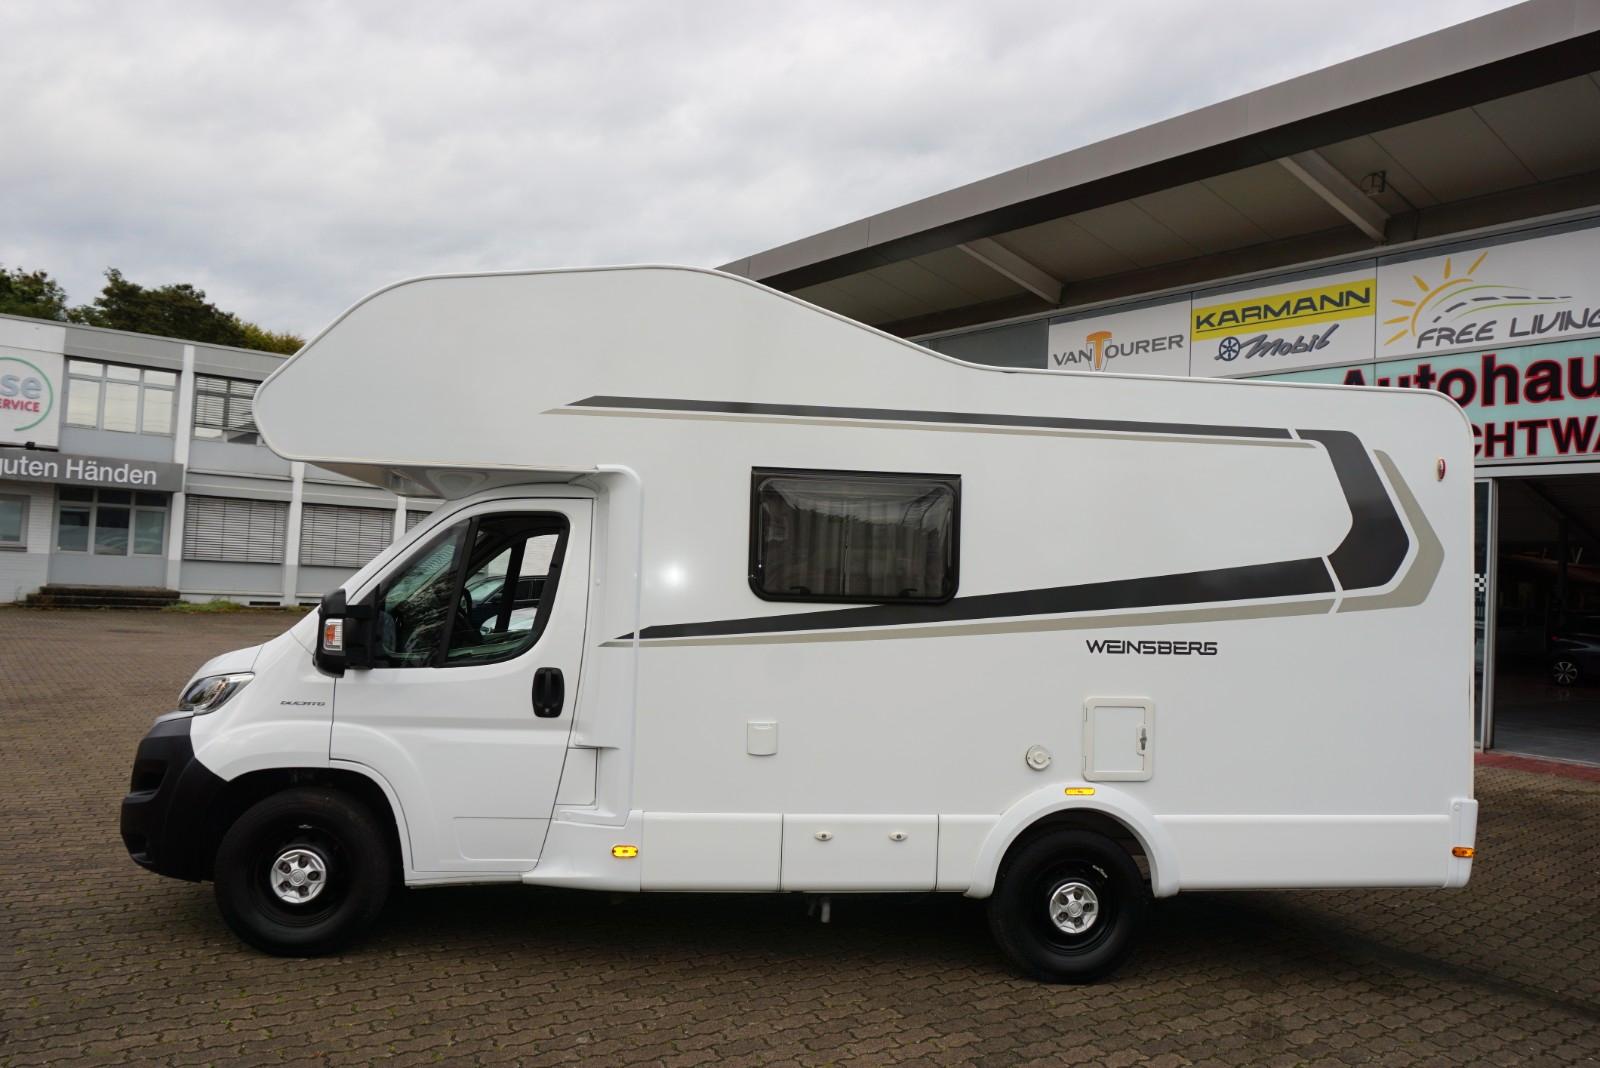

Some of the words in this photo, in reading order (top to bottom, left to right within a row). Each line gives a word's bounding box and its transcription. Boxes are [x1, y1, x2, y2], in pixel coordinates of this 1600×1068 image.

[1196, 287, 1370, 330] KARMANN
[1240, 323, 1340, 359] Mobil
[1417, 320, 1497, 349] FREE
[1053, 331, 1184, 371] VANTOURER
[0, 398, 41, 413] RVICE
[0, 455, 58, 478] uten
[66, 458, 157, 486] Händen
[1086, 639, 1218, 656] WEINSBERG
